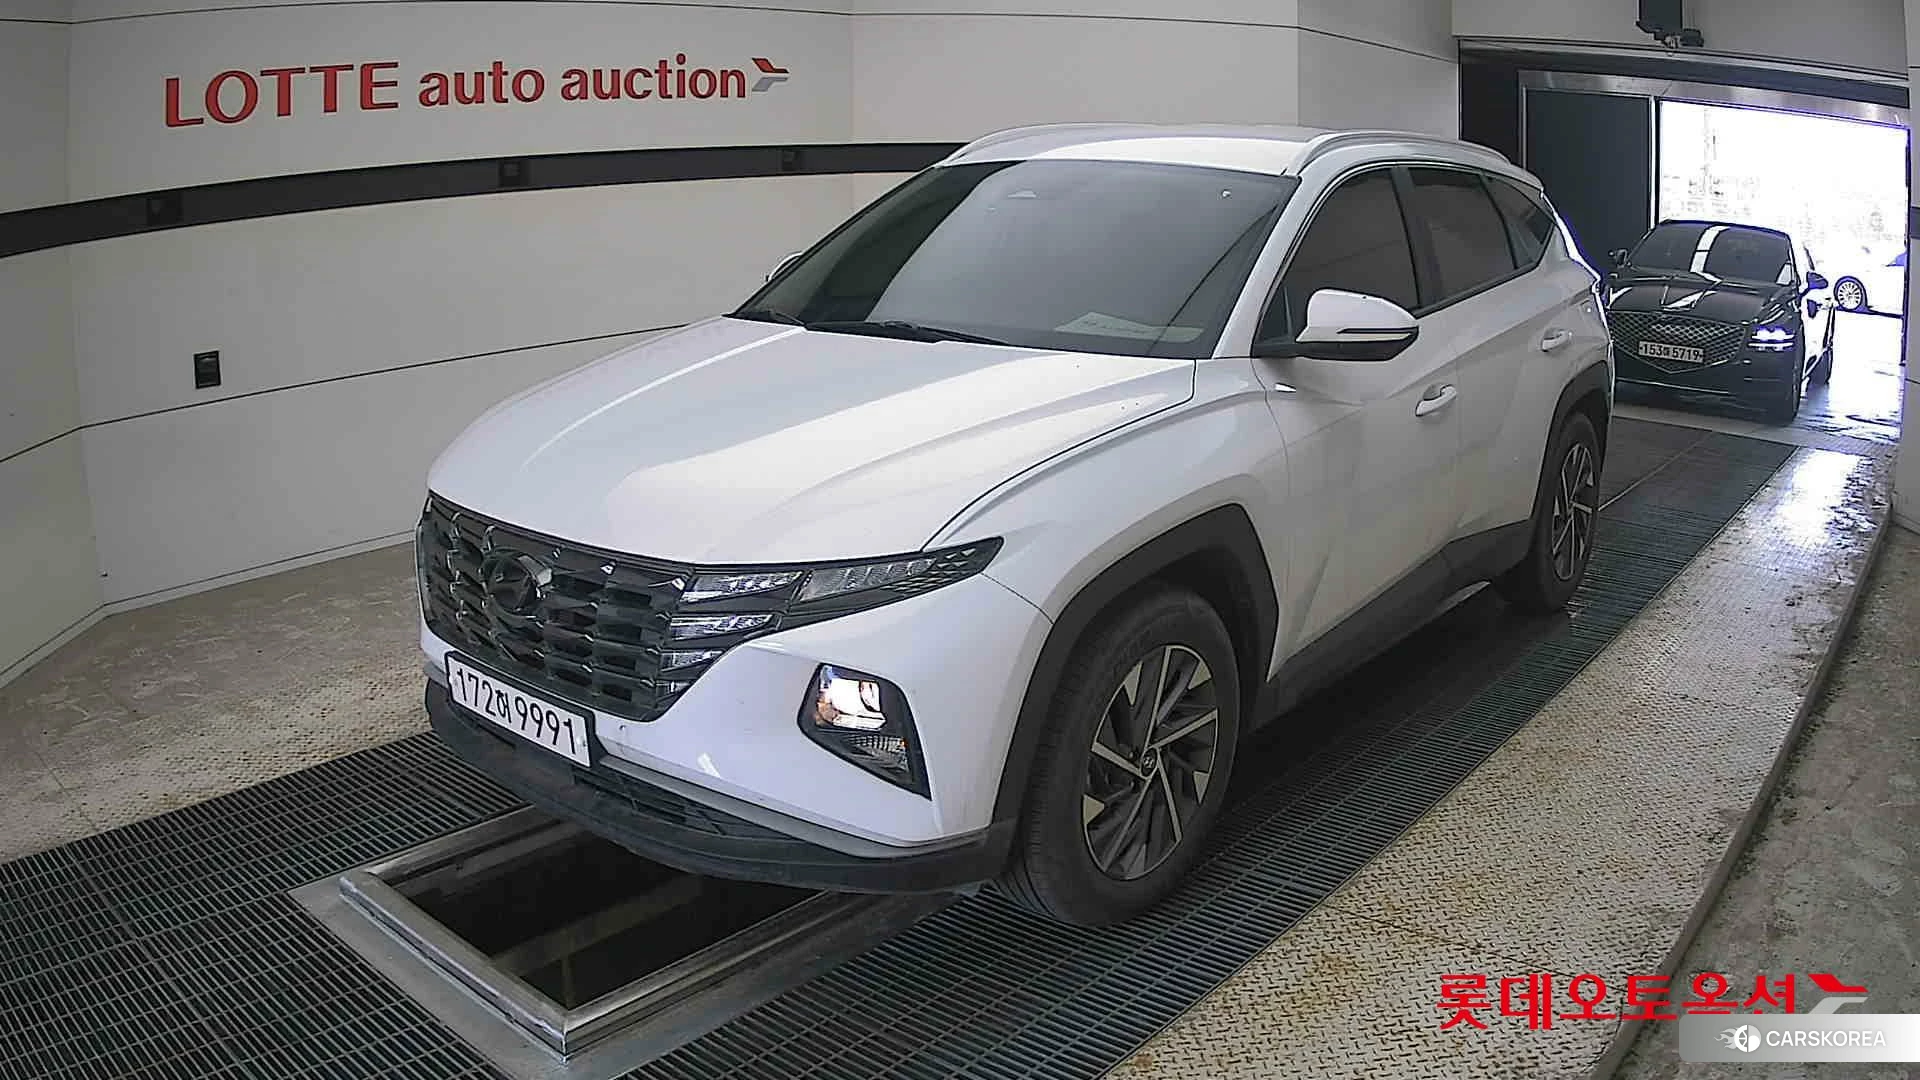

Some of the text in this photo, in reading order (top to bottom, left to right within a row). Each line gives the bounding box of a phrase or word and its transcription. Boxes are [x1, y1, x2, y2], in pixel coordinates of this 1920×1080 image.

[165, 53, 747, 128] LOTTE auto auction
[456, 667, 577, 756] 172허9991
